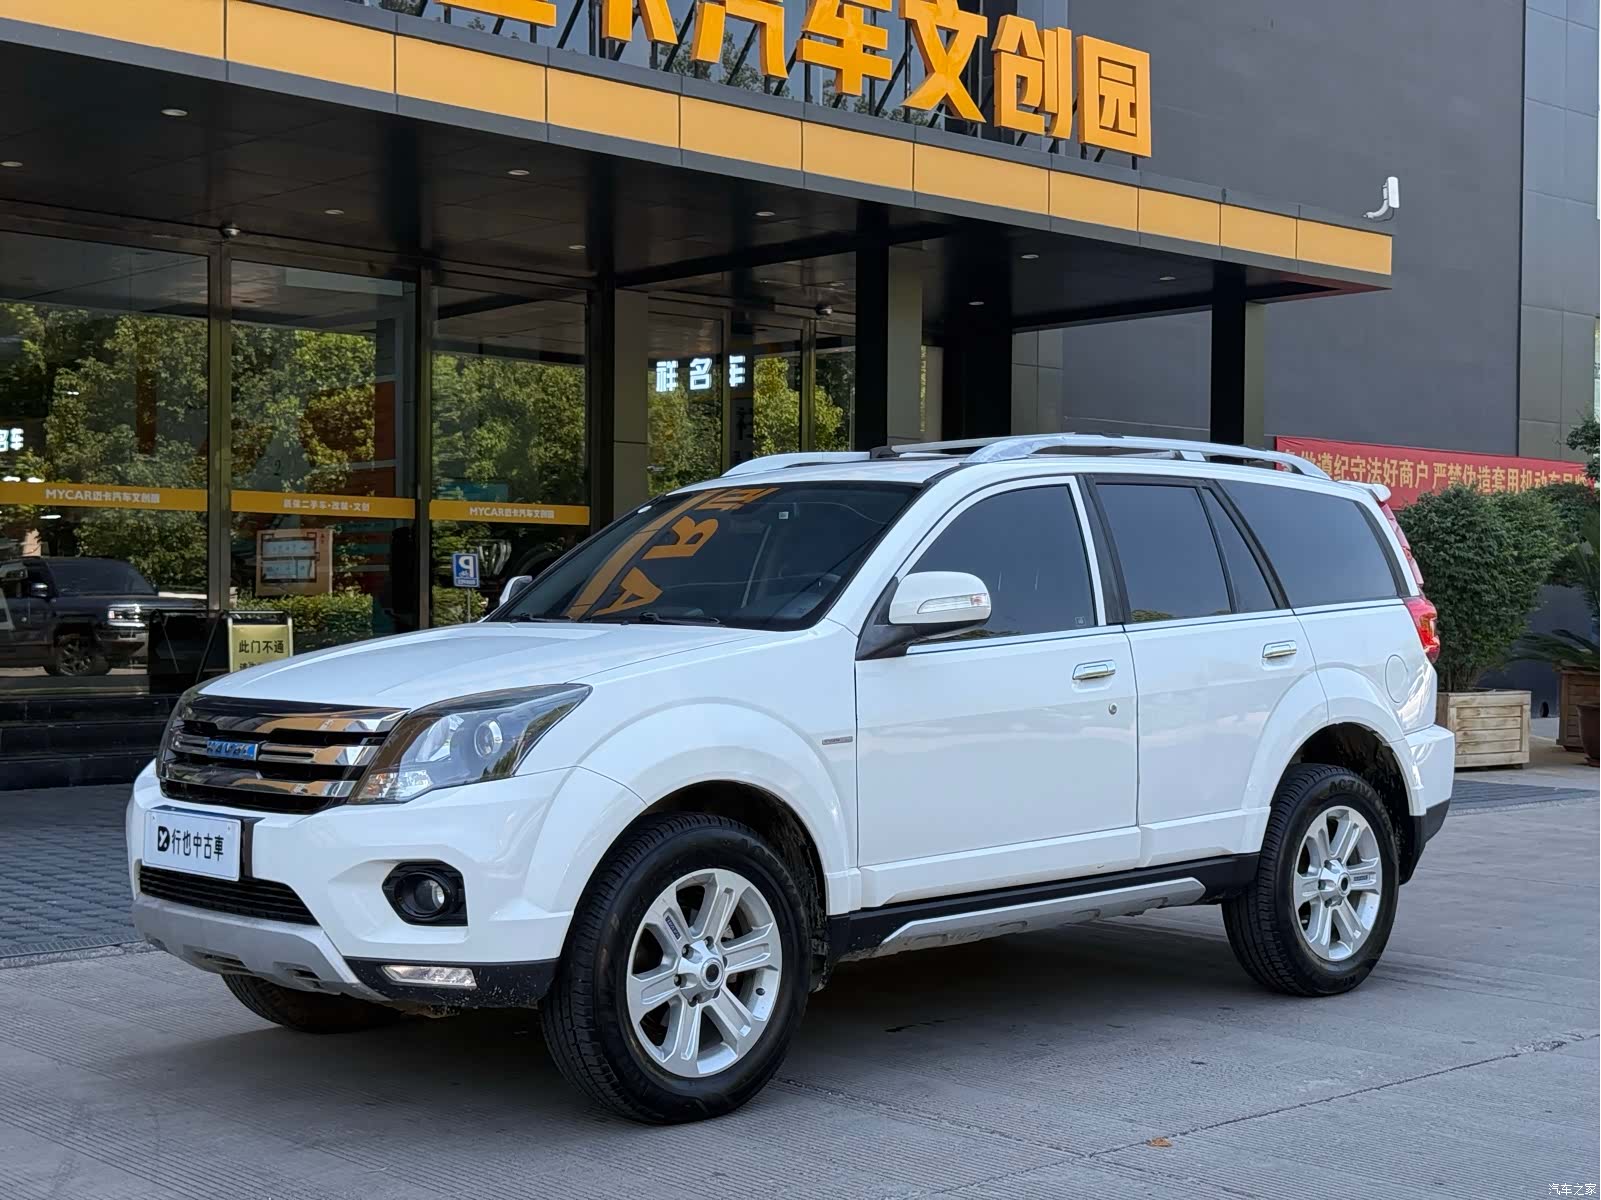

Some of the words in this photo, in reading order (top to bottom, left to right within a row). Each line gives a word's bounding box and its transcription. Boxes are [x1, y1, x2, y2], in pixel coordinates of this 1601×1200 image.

[239, 640, 285, 654] 此门不通
[171, 828, 224, 861] 行也中古車
